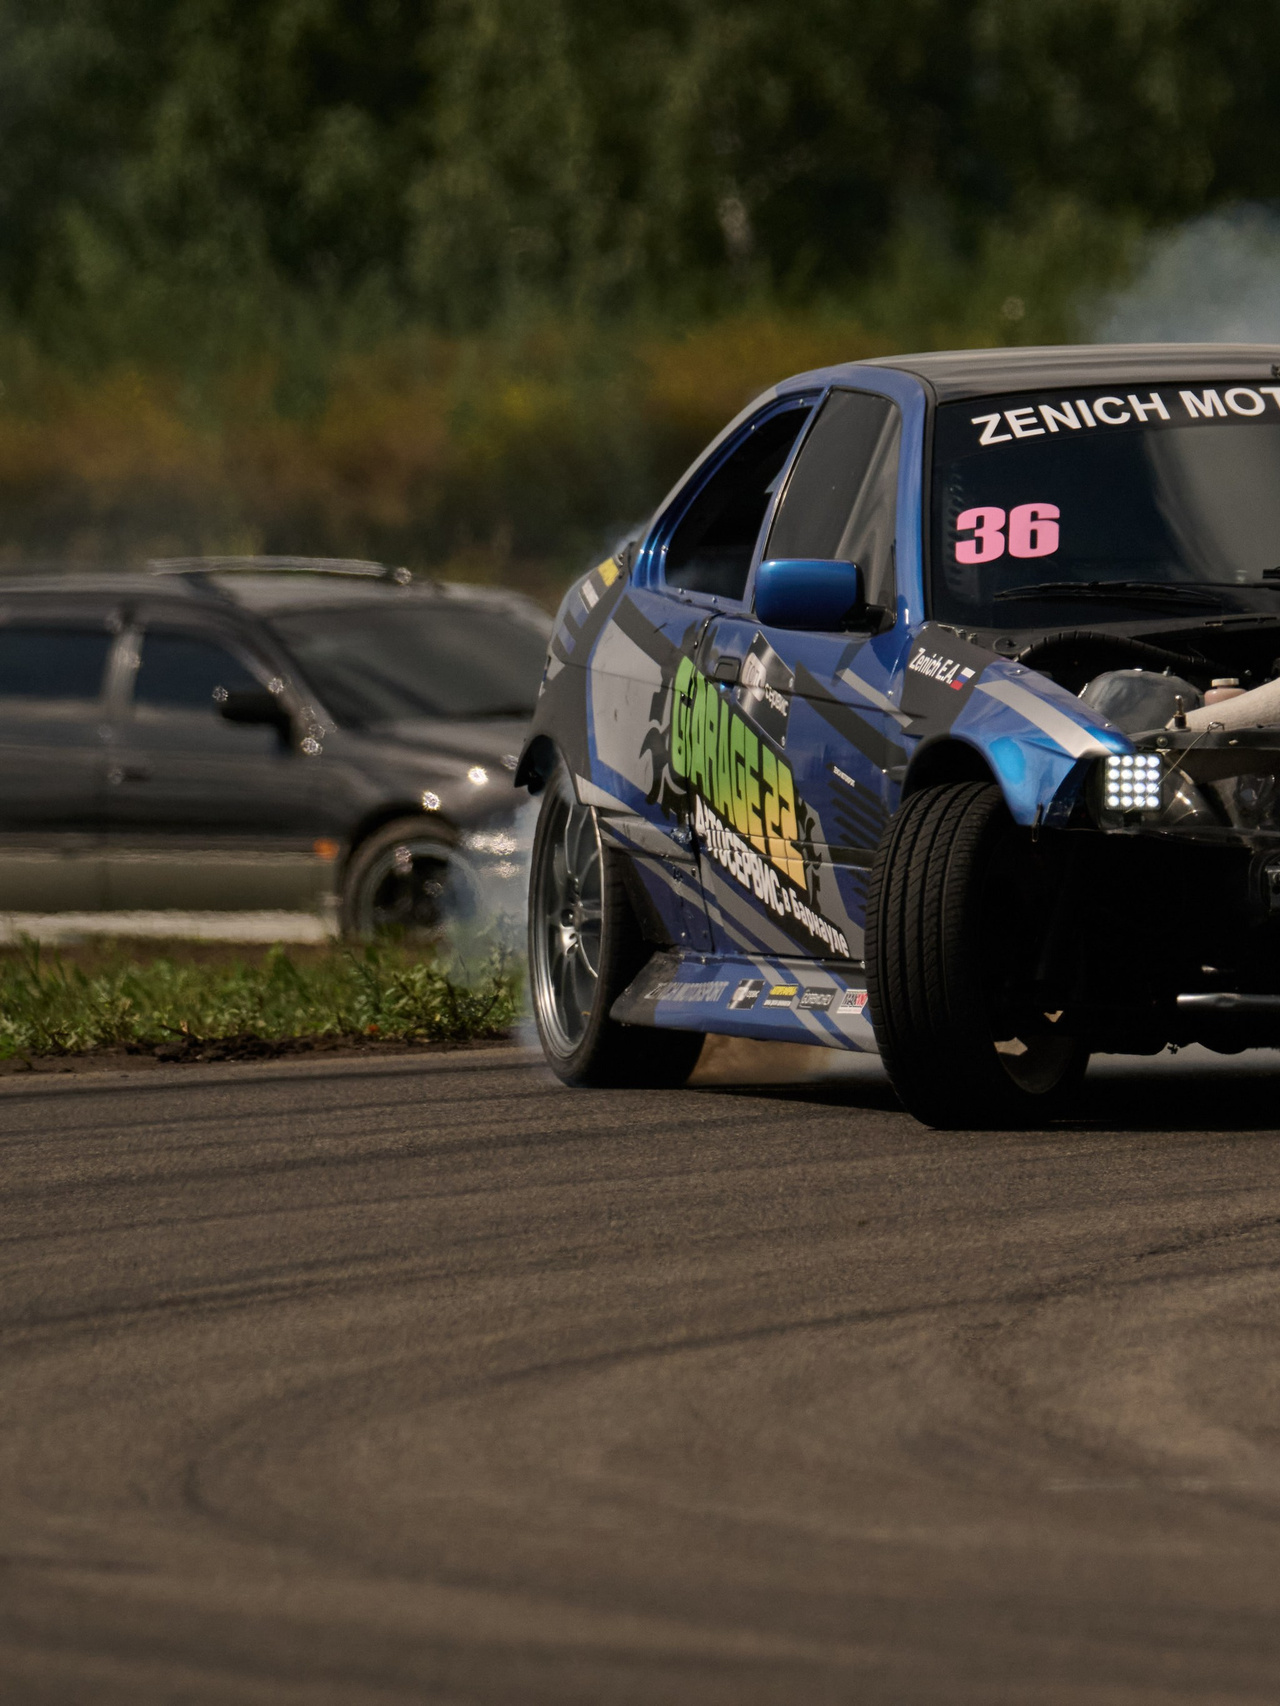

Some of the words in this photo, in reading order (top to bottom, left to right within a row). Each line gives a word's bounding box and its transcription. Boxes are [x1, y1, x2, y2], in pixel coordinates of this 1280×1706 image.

[971, 392, 1170, 446] ZENICH
[955, 503, 1061, 565] 36
[909, 647, 944, 678] Zenich
[672, 656, 767, 855] GARAGE
[762, 744, 807, 891] 22
[789, 887, 850, 958] Барнауле
